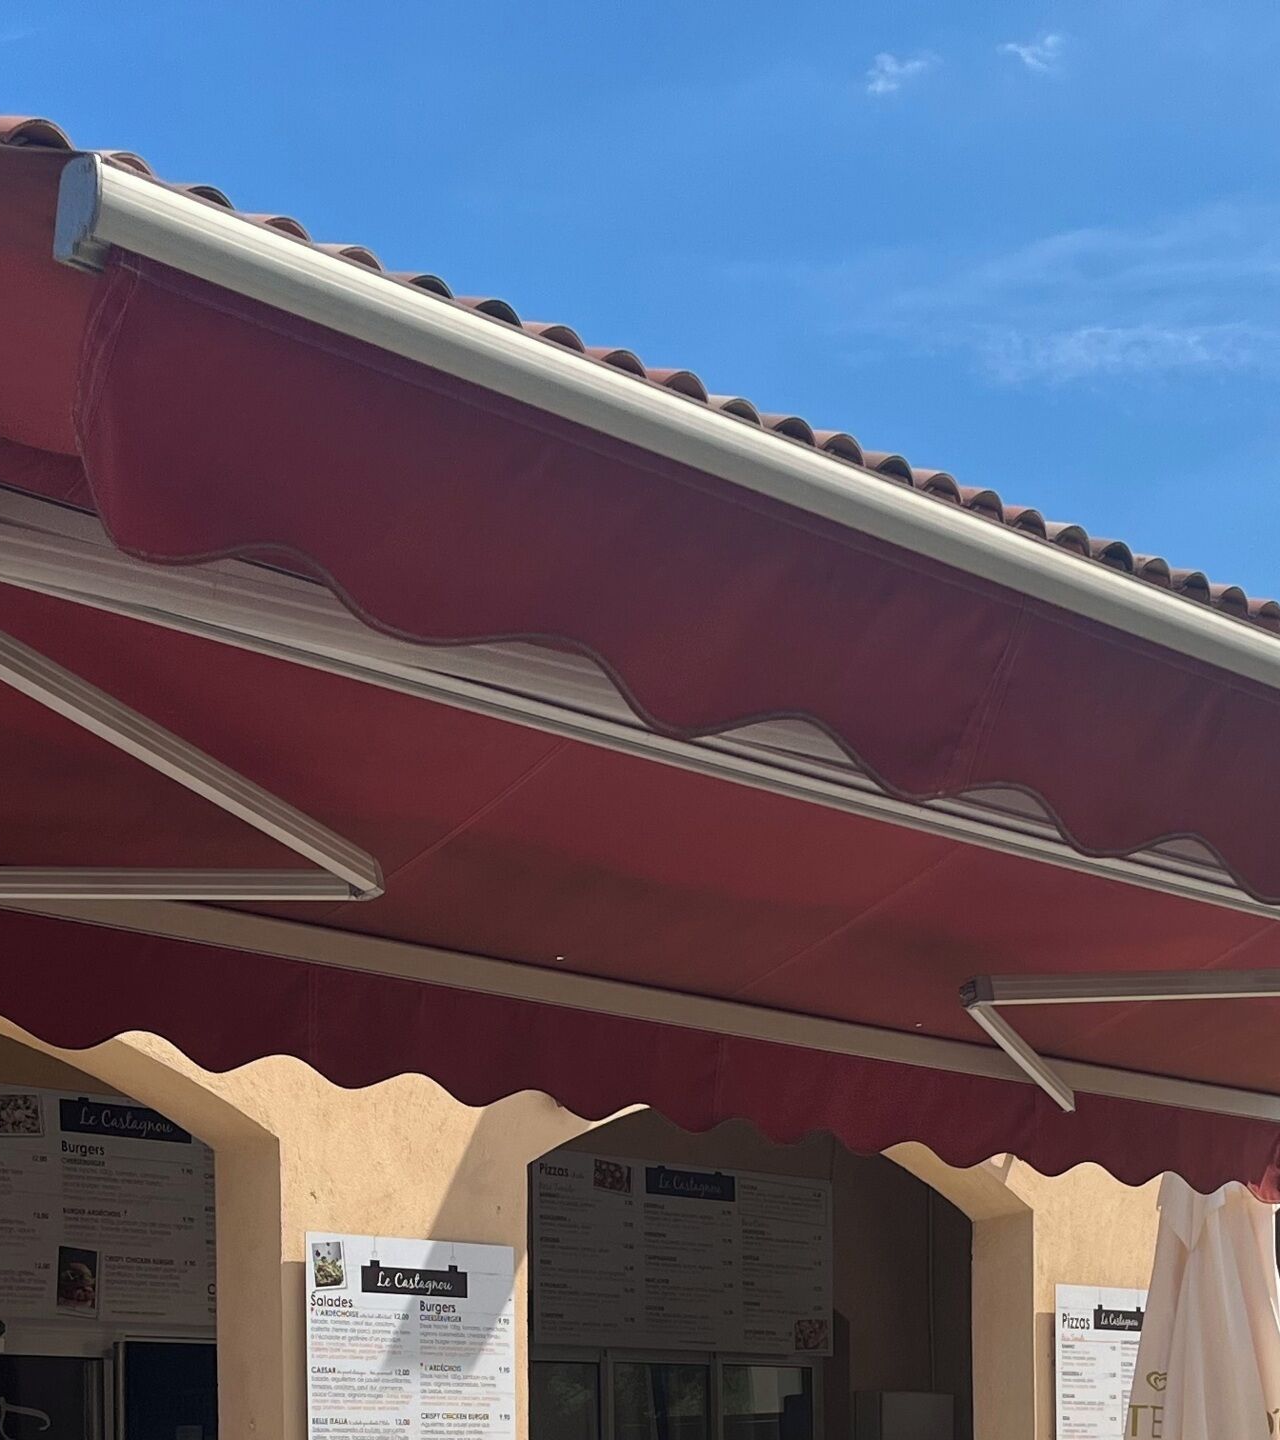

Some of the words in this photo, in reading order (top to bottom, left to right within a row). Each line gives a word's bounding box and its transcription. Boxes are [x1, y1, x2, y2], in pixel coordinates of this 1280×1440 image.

[80, 1106, 97, 1126] Le
[100, 1107, 175, 1137] Castagnou
[61, 1140, 106, 1157] Burgers
[539, 1162, 569, 1179] Pizzas
[376, 1271, 392, 1287] Le
[394, 1272, 453, 1295] Castagnou
[311, 1295, 353, 1308] Salades
[420, 1301, 456, 1314] Burgers
[1062, 1312, 1091, 1330] Pizzas
